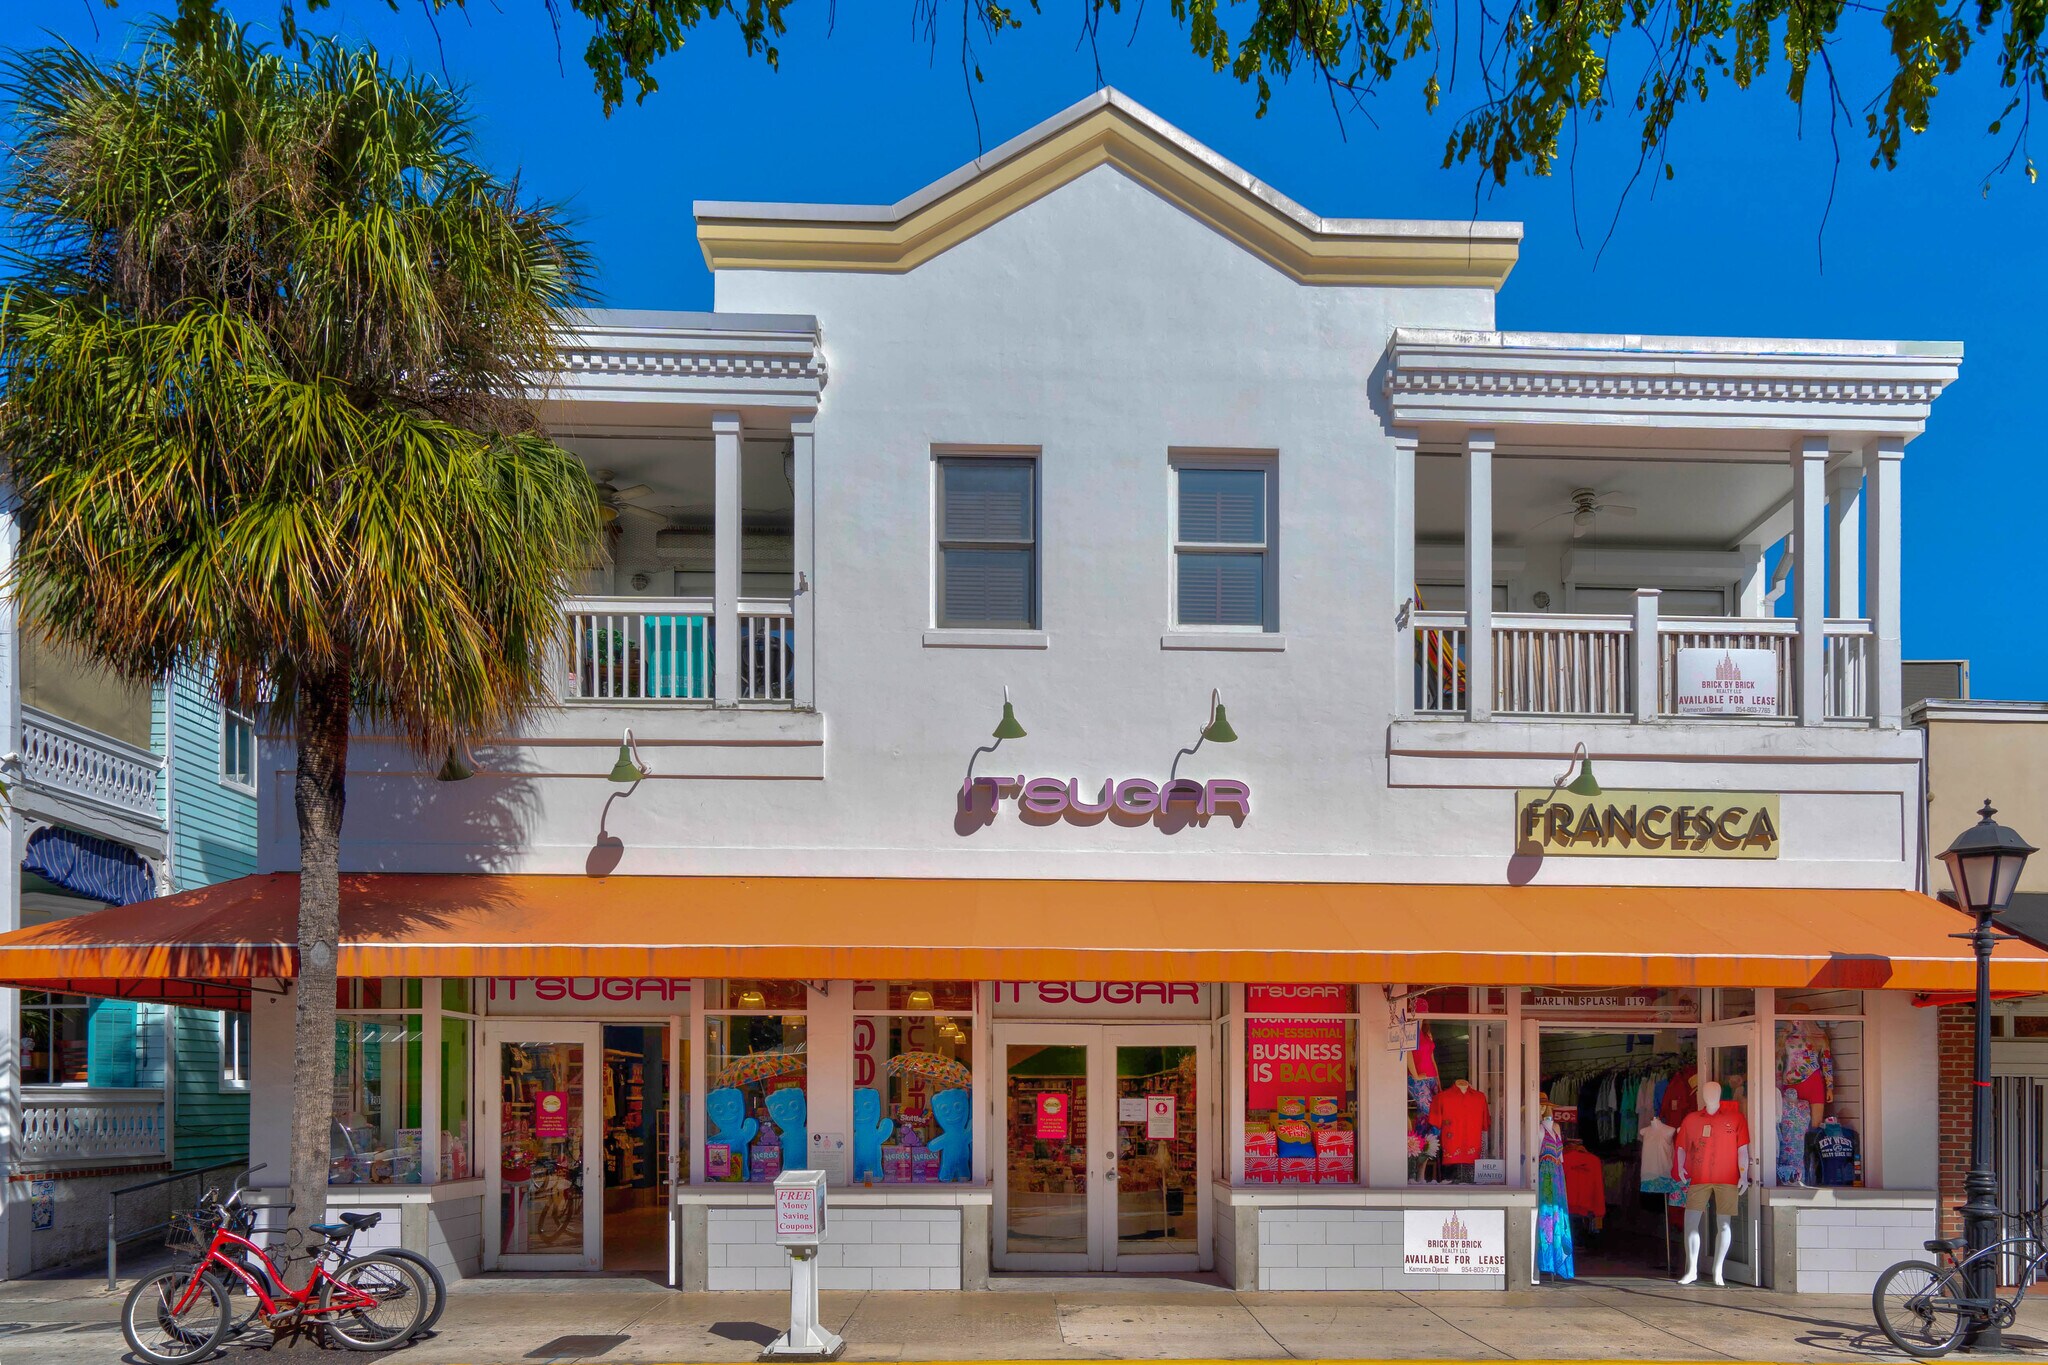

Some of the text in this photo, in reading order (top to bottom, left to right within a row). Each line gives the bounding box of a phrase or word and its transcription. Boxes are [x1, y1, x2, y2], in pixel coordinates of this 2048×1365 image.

[1702, 681, 1755, 690] BRICK BY BRICK
[1679, 695, 1775, 705] AVAILABLE FOR LEASE
[964, 774, 1251, 815] IT'SUGAR
[1527, 802, 1778, 842] FRANCESCA
[994, 980, 1199, 1004] ITSUGAR
[1250, 986, 1339, 997] IT'SUGAR
[1535, 997, 1645, 1006] MARLIN SPLASH 119
[1252, 1028, 1342, 1038] NON-ESSENTIAL
[1253, 1044, 1342, 1060] BUSINESS
[1253, 1063, 1342, 1082] IS BACK
[1288, 1130, 1306, 1138] Fish
[1819, 1137, 1852, 1149] KEY WEST
[779, 1191, 811, 1200] FREE
[783, 1202, 808, 1210] Money
[779, 1222, 813, 1231] Coupons
[1428, 1240, 1482, 1248] BRICK BY BRICK
[1405, 1255, 1504, 1265] AVAILABLE FOR LEASE
